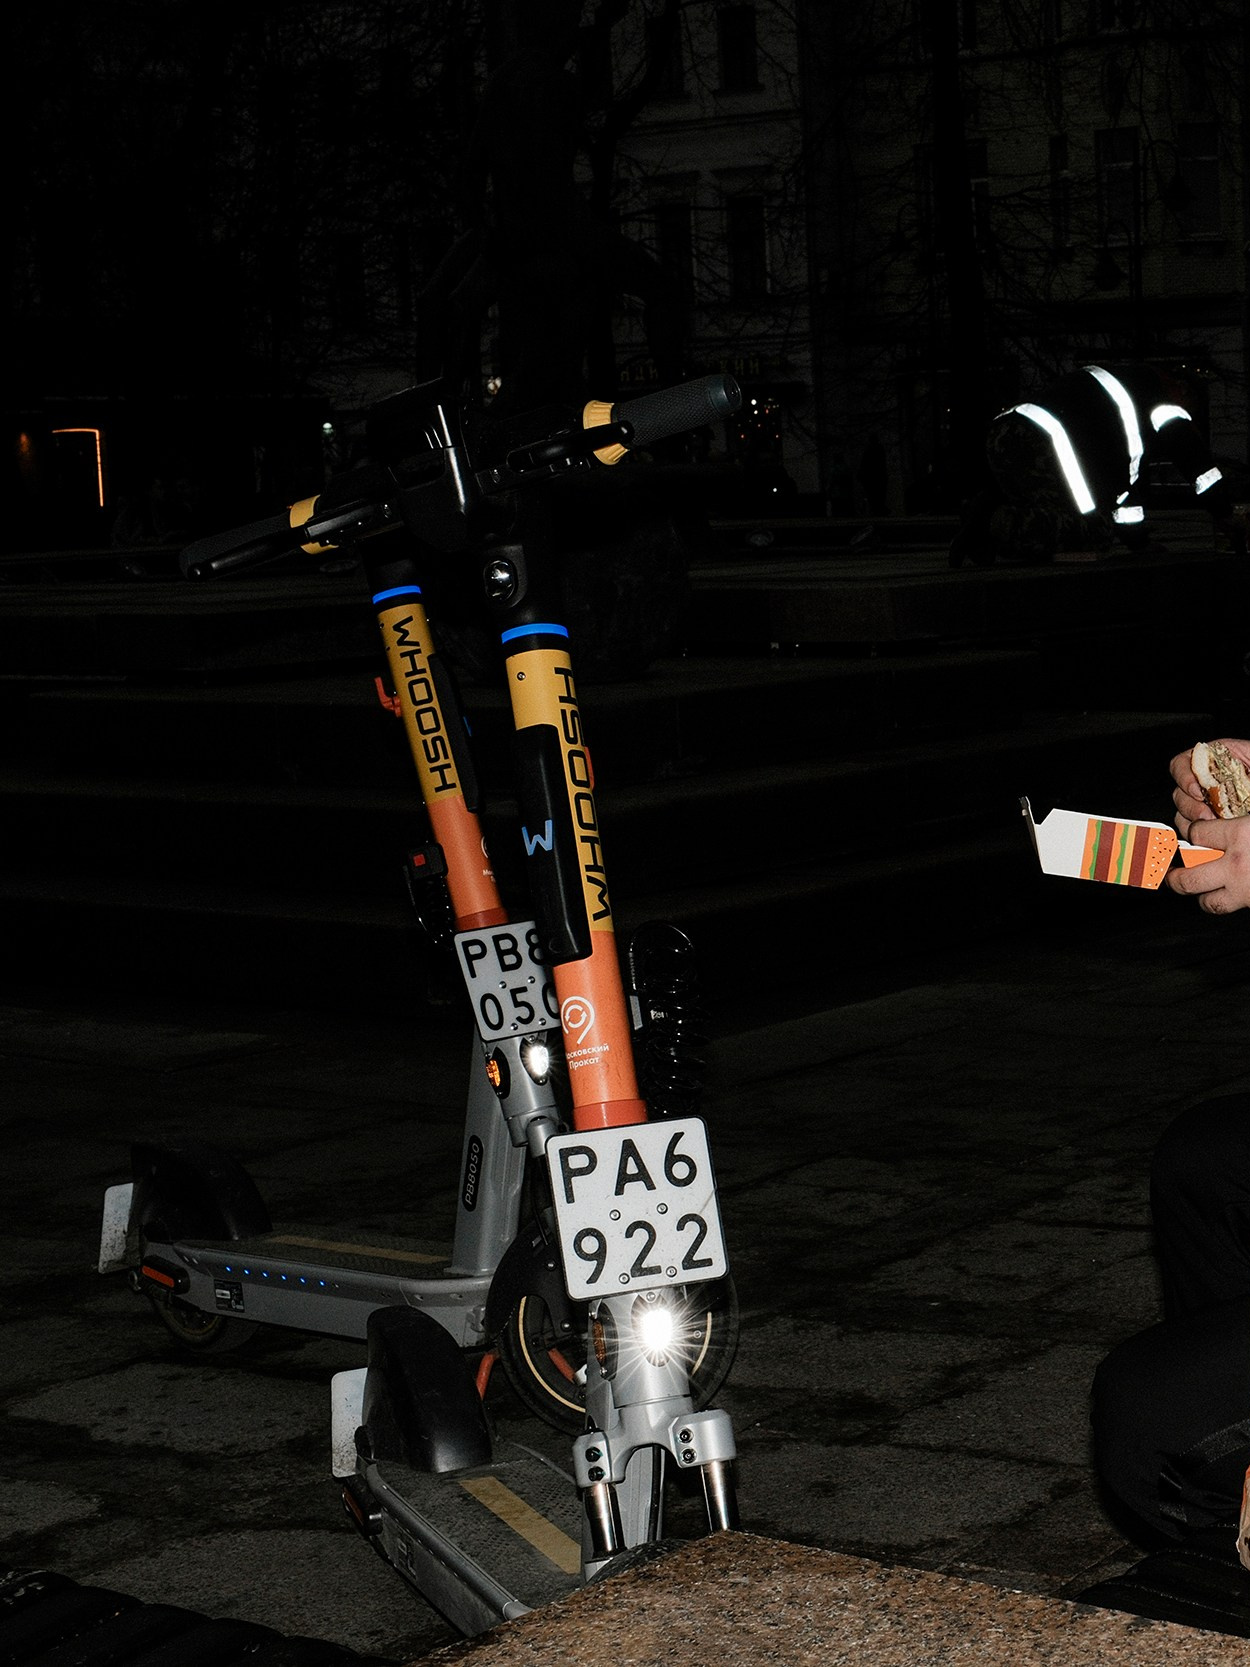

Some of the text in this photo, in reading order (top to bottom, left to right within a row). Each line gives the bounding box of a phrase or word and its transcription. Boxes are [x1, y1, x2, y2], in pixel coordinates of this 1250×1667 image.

[392, 615, 457, 793] WHOOSH
[554, 666, 612, 921] WHOOSH
[521, 819, 554, 856] W
[566, 1043, 610, 1060] осковский
[569, 1057, 600, 1070] Прокат
[464, 1142, 480, 1206] PB8050
[559, 1131, 697, 1204] PA6
[573, 1214, 712, 1285] 922
